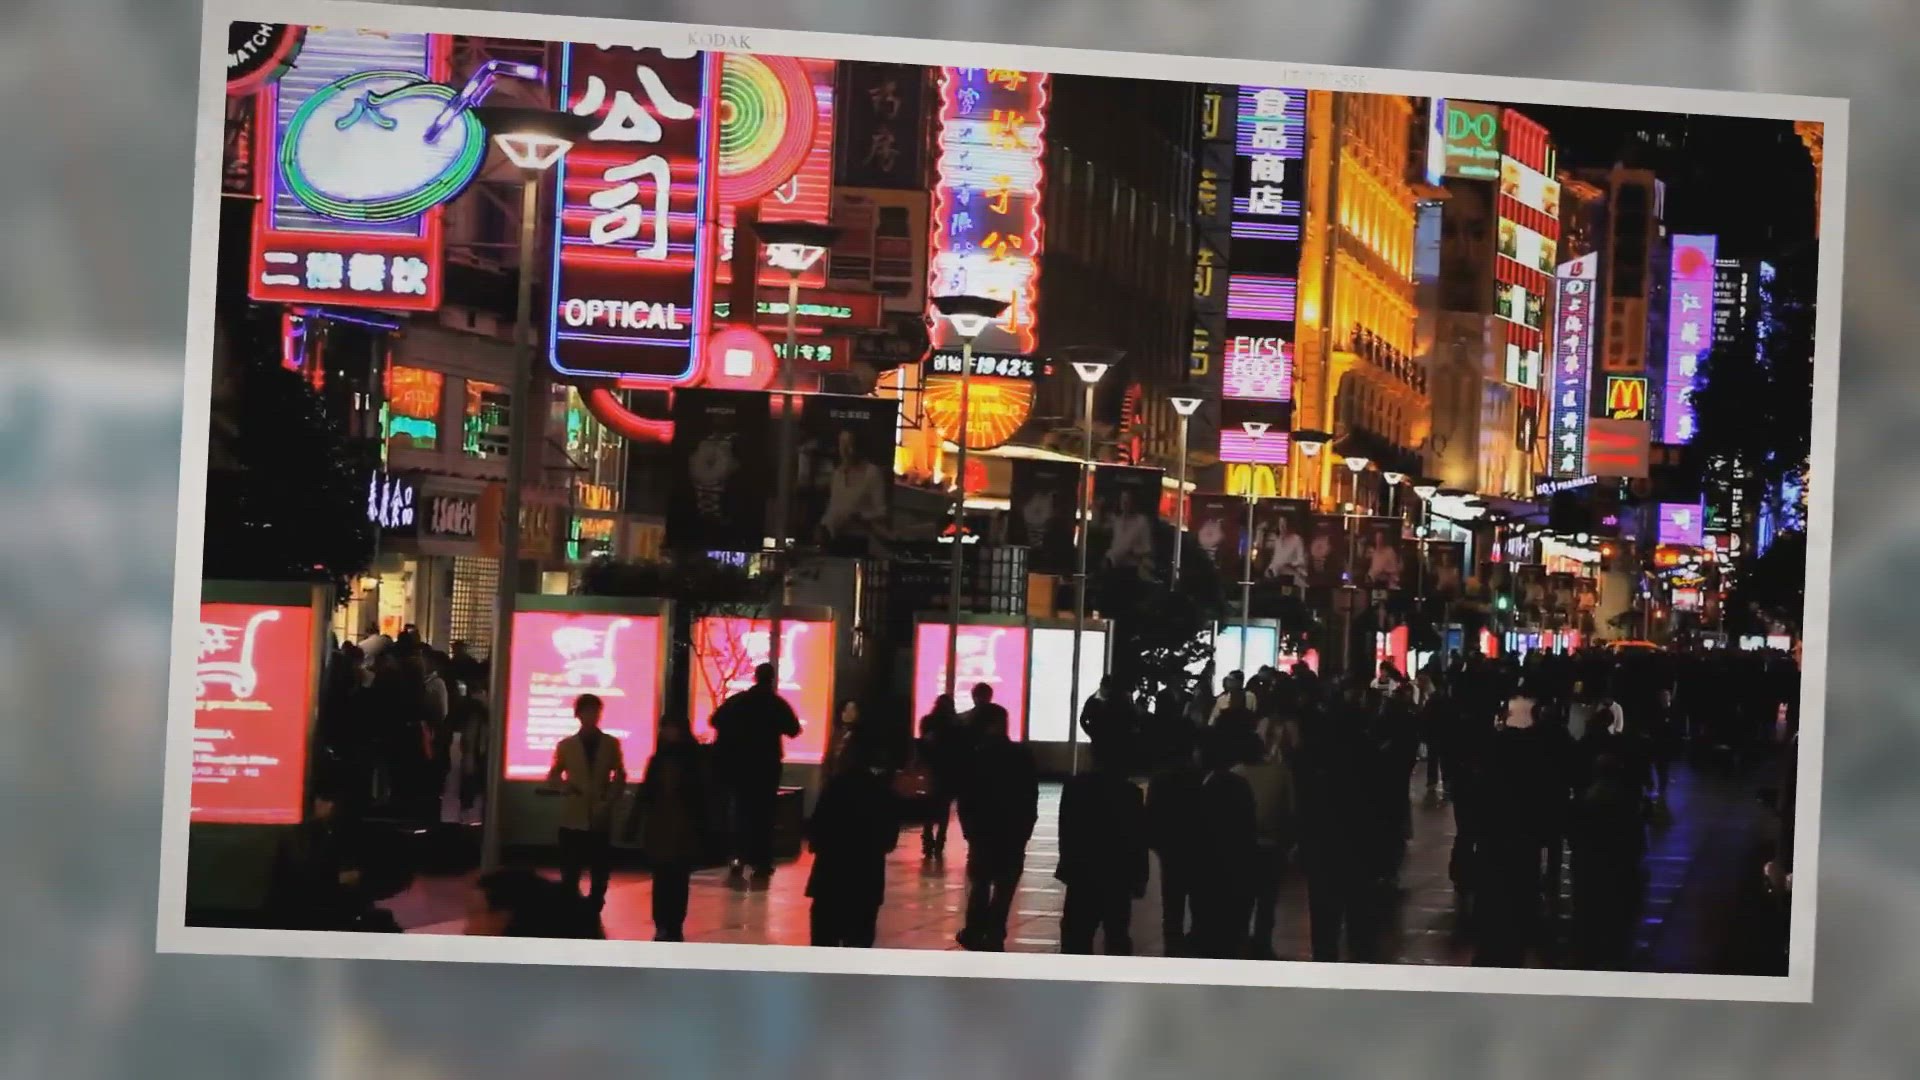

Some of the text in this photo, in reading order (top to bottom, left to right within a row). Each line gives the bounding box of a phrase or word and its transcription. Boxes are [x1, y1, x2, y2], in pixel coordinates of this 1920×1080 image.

[688, 32, 753, 49] KODAK
[573, 46, 695, 260] 公司
[1248, 89, 1291, 215] 食品商店
[563, 299, 684, 330] OPTICAL
[1557, 475, 1598, 490] PHARMACY
